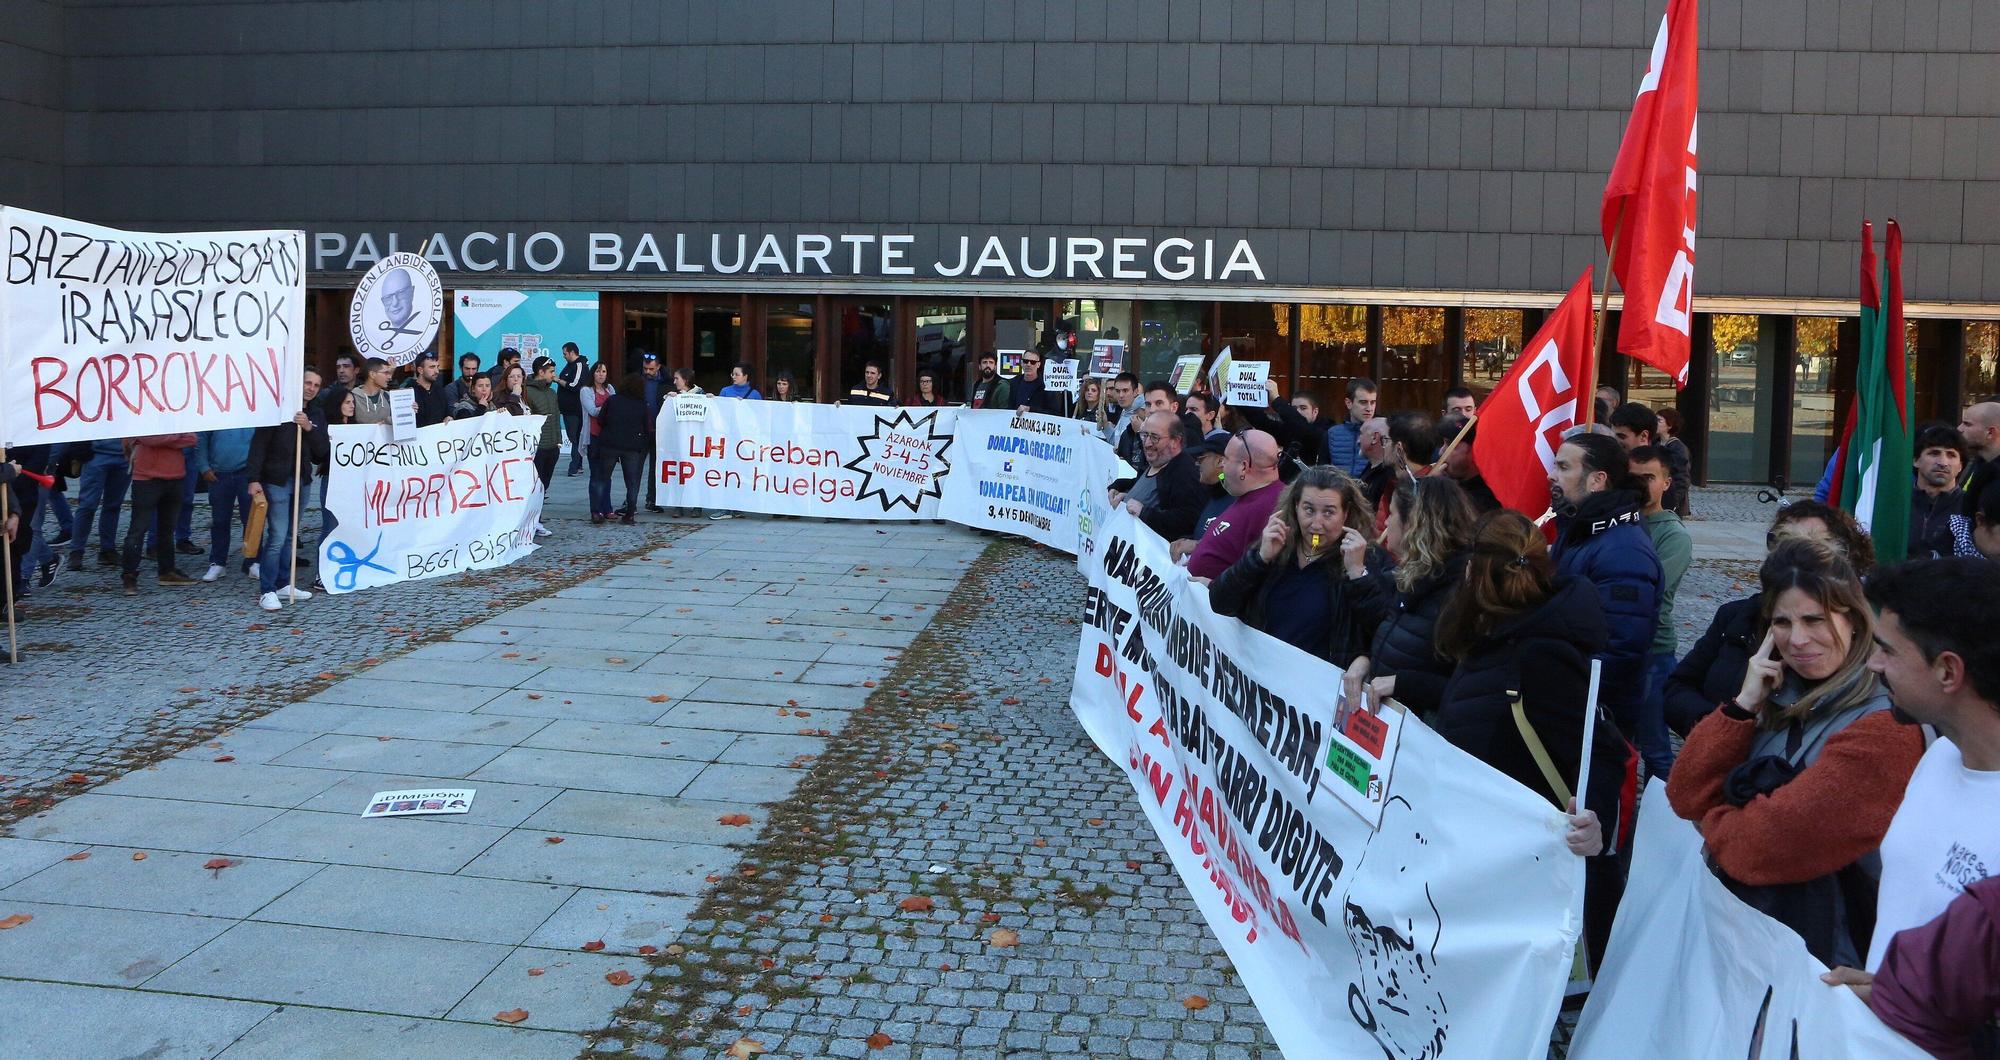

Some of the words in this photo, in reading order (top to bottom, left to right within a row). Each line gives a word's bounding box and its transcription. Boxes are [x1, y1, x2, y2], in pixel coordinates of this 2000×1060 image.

[589, 232, 916, 275] BALUARTE
[933, 235, 1266, 281] JAUREGIA
[351, 272, 376, 353] ORONOZEN
[377, 253, 428, 274] LANBIDE
[426, 269, 441, 326] ESKOLA
[1053, 366, 1069, 374] DUAL
[1239, 371, 1257, 381] DUAL
[1041, 421, 1047, 433] 4
[1047, 422, 1056, 436] ETA
[1056, 424, 1061, 436] 5
[335, 441, 428, 466] GOBERNU
[689, 435, 726, 460] LH
[736, 439, 840, 468] Greban
[886, 432, 932, 452] AZAROAK
[881, 444, 930, 470] 3-4-5
[661, 460, 695, 485] FP
[704, 469, 741, 489] en
[752, 467, 855, 503] huelga
[873, 462, 928, 485] NOVIEMBRE
[998, 507, 1004, 518] 4
[1005, 507, 1011, 519] Y
[1012, 509, 1018, 520] 5
[407, 544, 459, 578] BEGI
[380, 792, 464, 801] ¡DIMISIÓN!
[1258, 788, 1344, 927] DIGUTE
